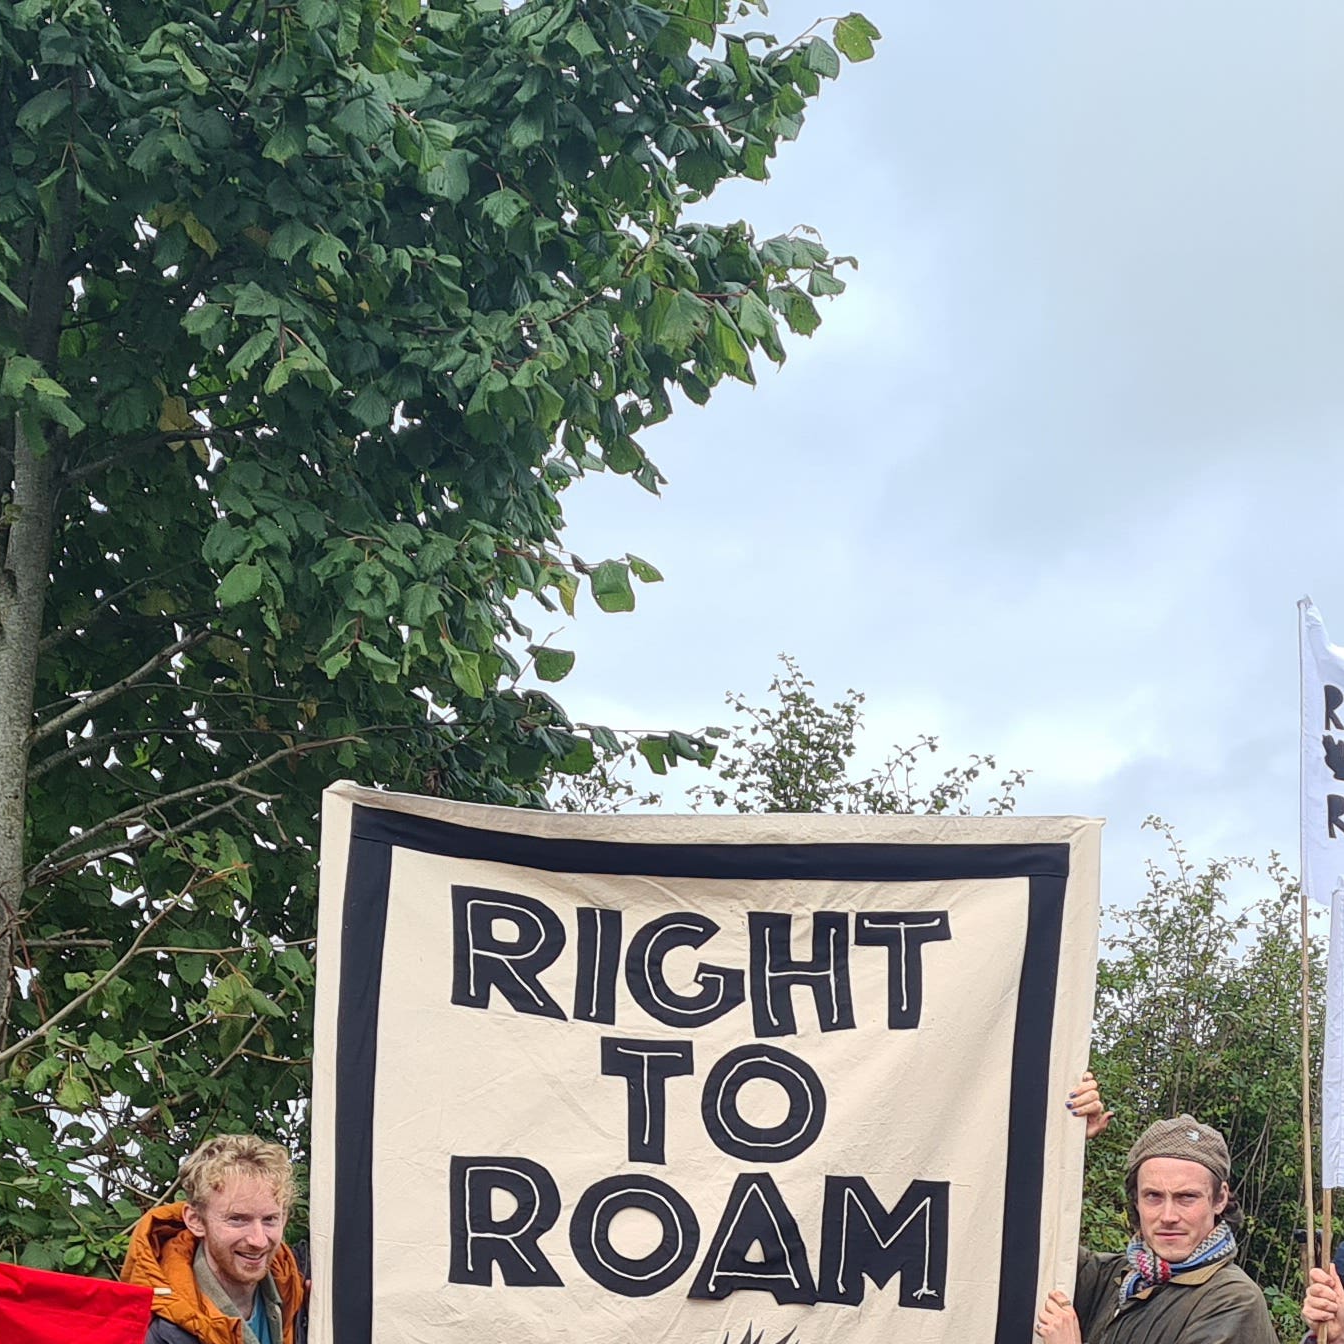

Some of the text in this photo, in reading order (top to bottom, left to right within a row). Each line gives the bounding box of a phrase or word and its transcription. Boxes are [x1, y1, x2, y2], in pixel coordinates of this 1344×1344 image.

[450, 884, 952, 1038] RIGHT
[600, 1036, 827, 1165] TO
[447, 1154, 951, 1311] ROAM
